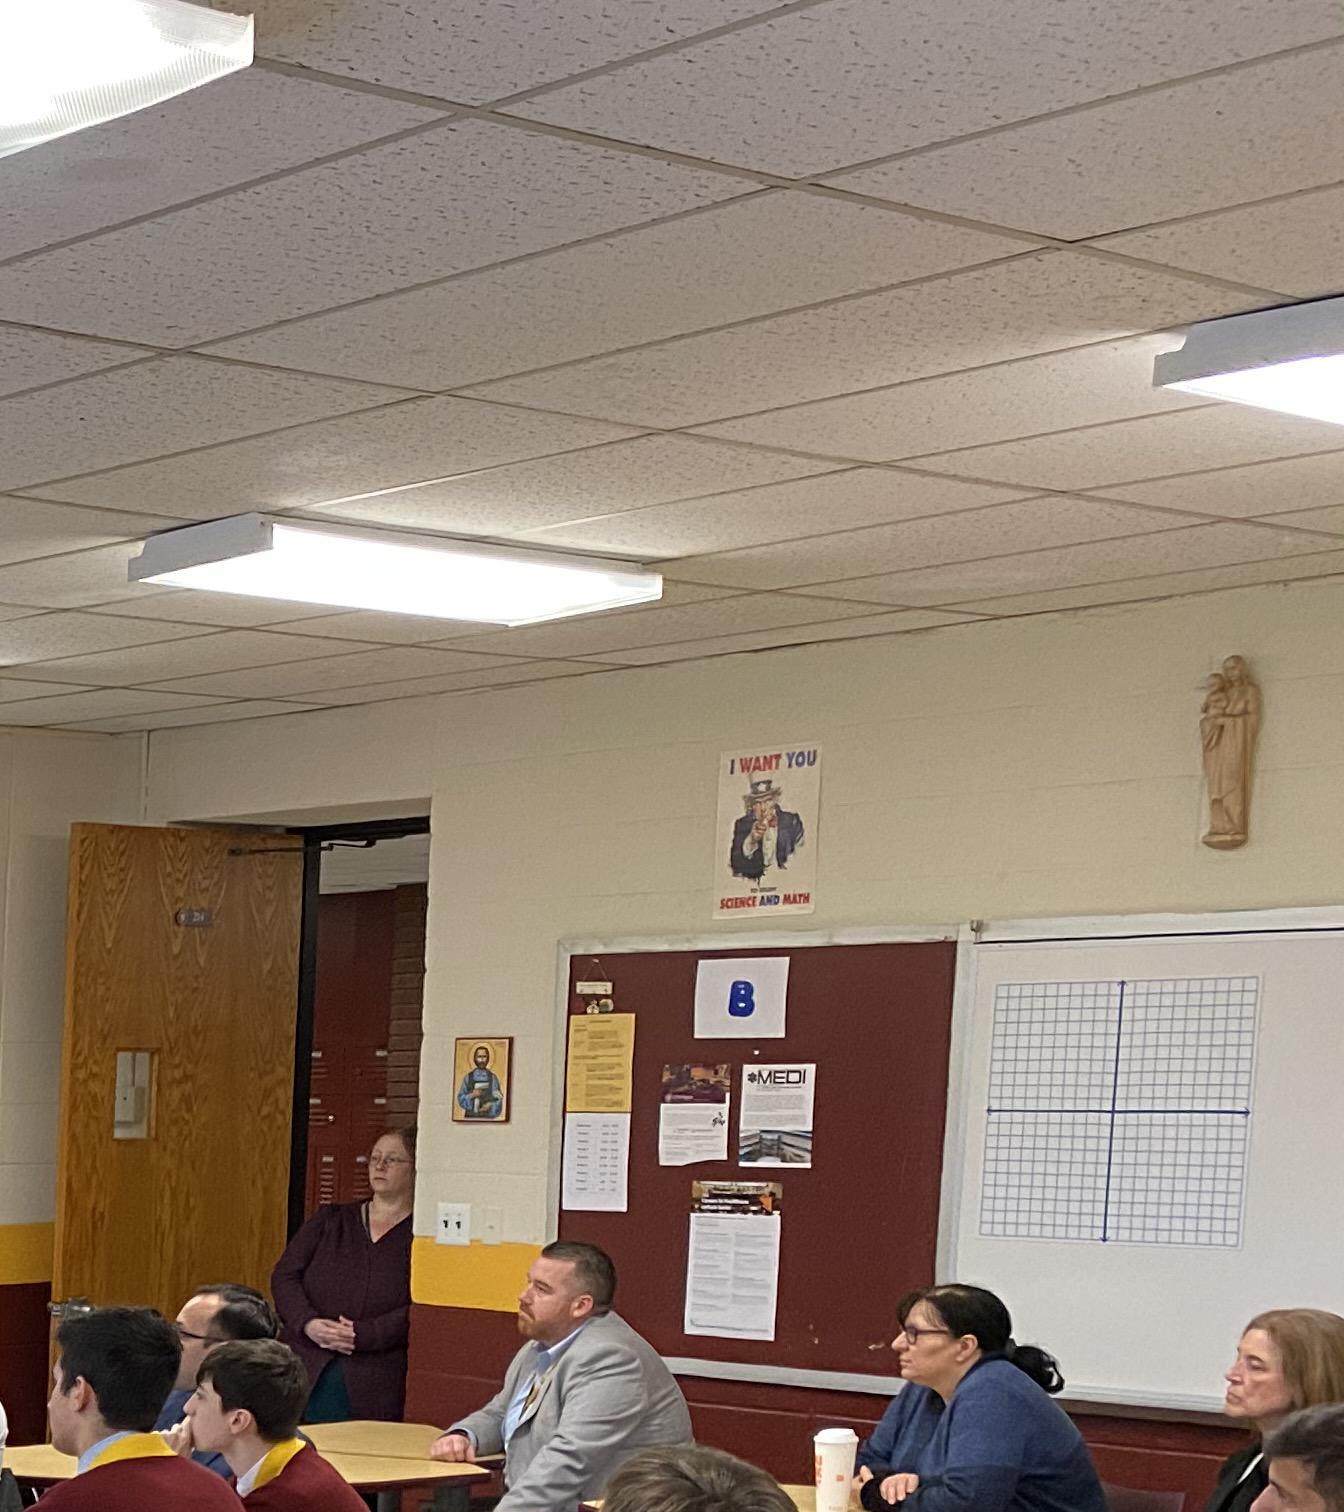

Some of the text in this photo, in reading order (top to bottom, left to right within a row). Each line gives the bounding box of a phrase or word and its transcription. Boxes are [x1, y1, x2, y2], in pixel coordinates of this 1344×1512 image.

[729, 750, 817, 775] I WANT YOU
[720, 893, 810, 909] SCIENCE AND MATH
[728, 980, 755, 1018] B
[757, 1069, 807, 1085] MEDI
